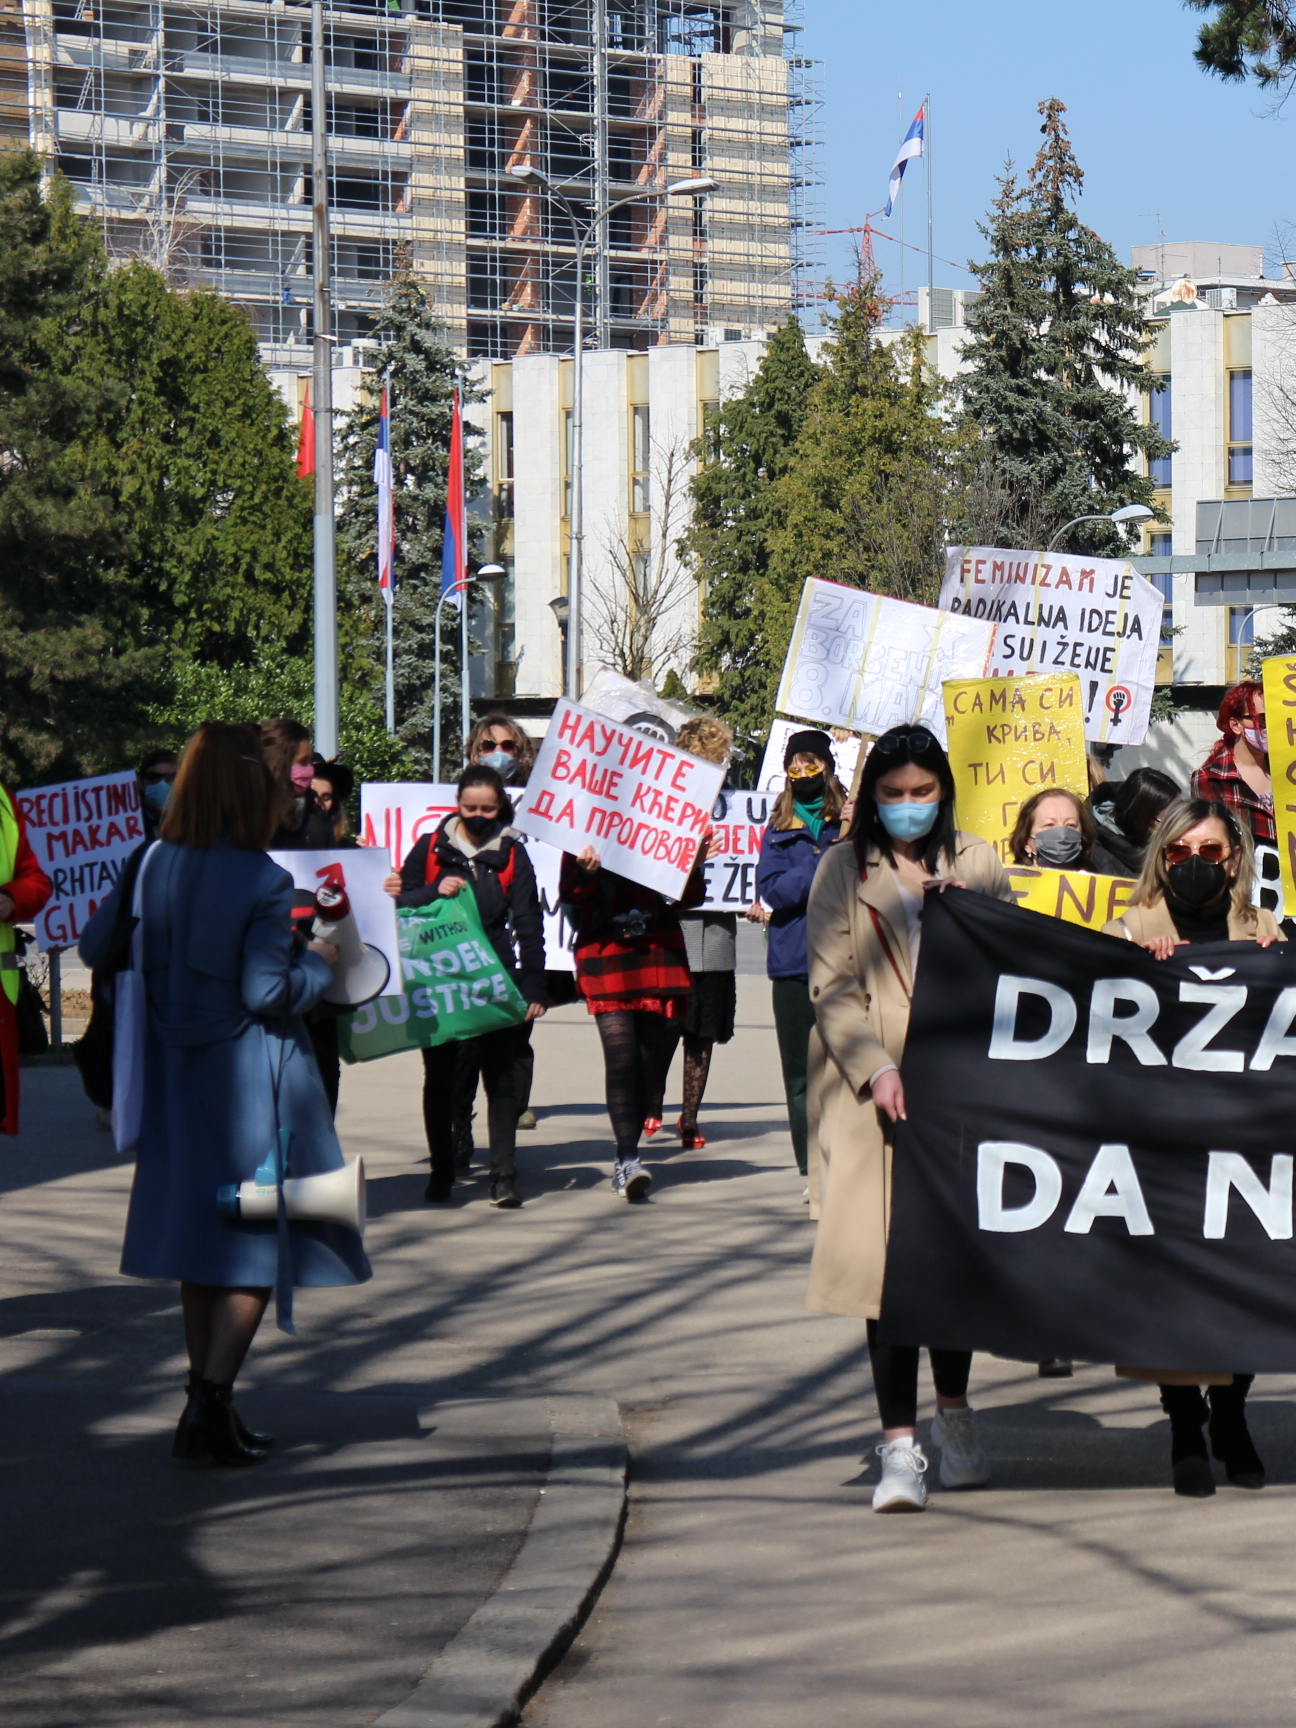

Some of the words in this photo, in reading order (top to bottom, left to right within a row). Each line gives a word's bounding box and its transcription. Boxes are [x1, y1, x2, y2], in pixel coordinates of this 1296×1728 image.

[960, 559, 1095, 593] FEMINIZAM
[1105, 574, 1134, 600] JE
[808, 591, 867, 638] ZA
[1079, 608, 1143, 641] IDEJA
[1002, 634, 1034, 662] SU
[1052, 635, 1116, 673] ŽENE
[789, 660, 832, 716] 8.
[1039, 686, 1074, 709] СИ
[557, 709, 695, 792] НАУЧИТЕ
[969, 761, 1006, 786] ТИ
[1022, 760, 1056, 785] СИ
[527, 789, 574, 829] ДА
[550, 749, 623, 801] ВАШЕ
[630, 782, 709, 836] КЋЕРИ
[46, 816, 143, 861] MAKAR
[351, 972, 508, 1034] JUSTICE
[977, 1141, 1155, 1236] DA
